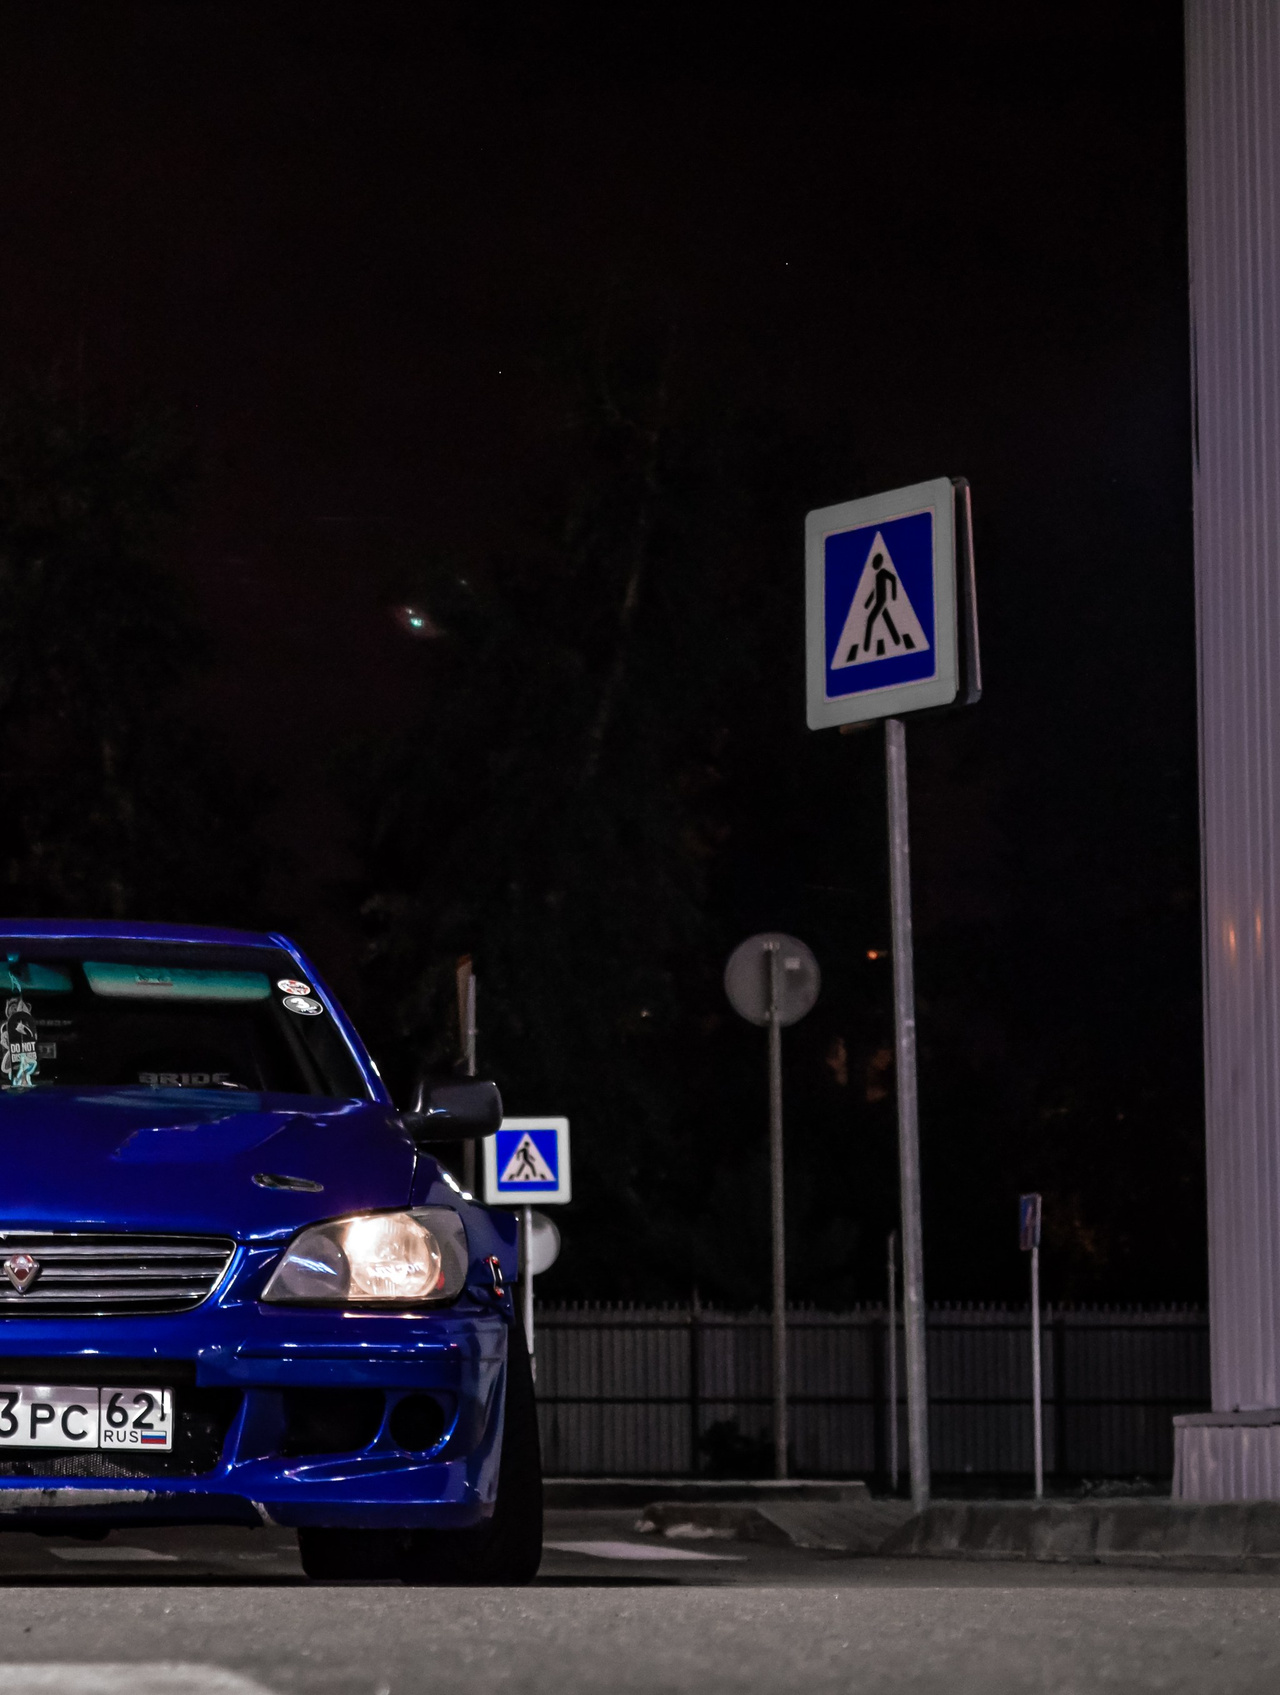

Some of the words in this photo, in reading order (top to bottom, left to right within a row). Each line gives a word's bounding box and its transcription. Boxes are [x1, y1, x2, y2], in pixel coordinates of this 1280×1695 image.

[10, 1043, 21, 1053] DO
[21, 1041, 36, 1052] NOT
[105, 1393, 155, 1430] 62
[103, 1430, 139, 1444] RUS
